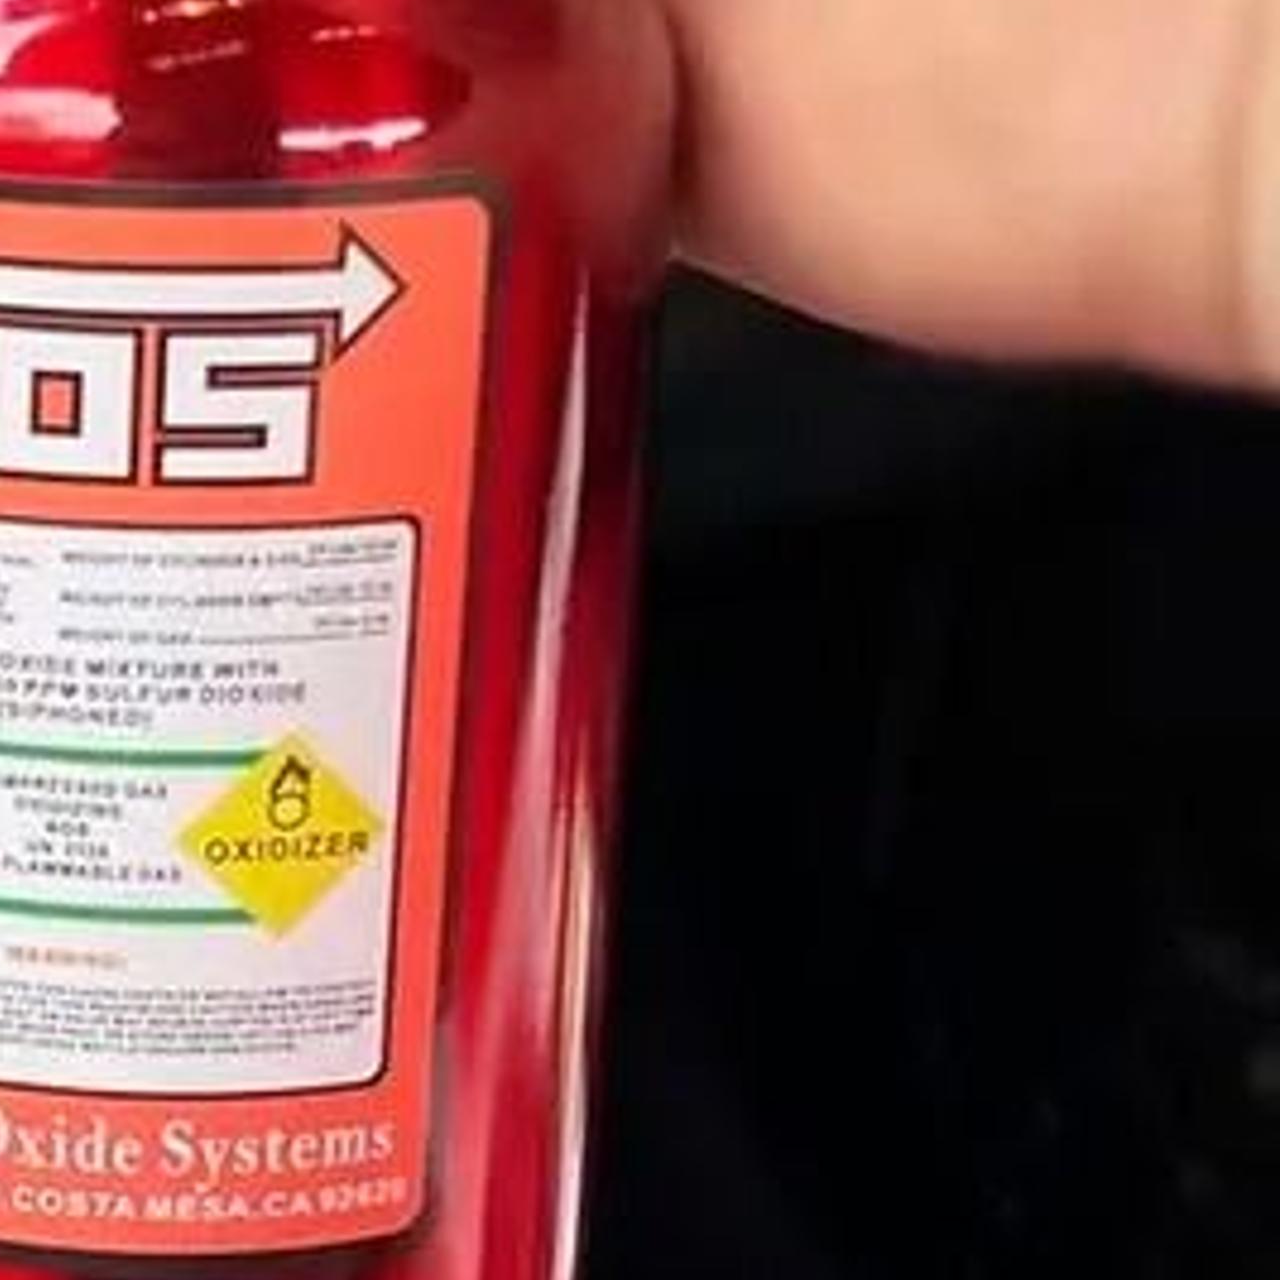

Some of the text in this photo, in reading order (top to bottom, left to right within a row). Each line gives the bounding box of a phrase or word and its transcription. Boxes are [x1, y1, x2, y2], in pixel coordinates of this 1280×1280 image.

[204, 830, 370, 865] OXIDIZER
[160, 1118, 395, 1195] Systems
[11, 1185, 136, 1219] COSTA
